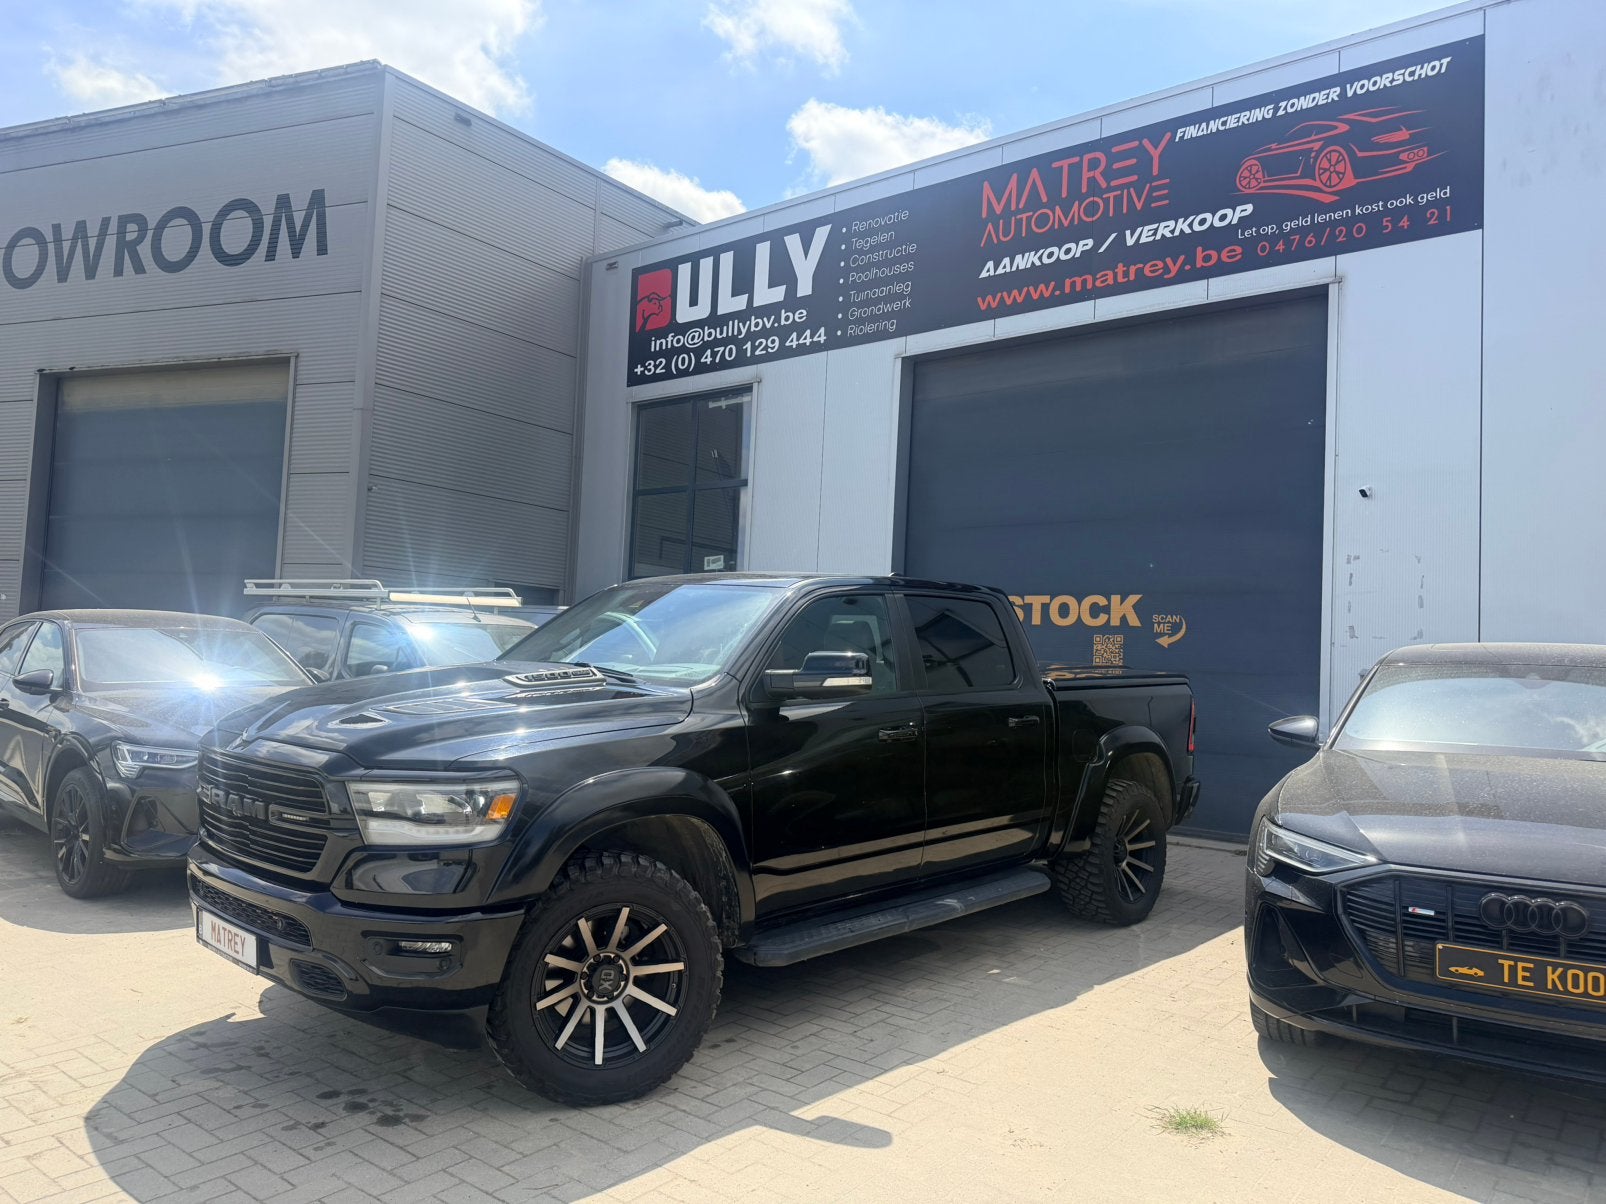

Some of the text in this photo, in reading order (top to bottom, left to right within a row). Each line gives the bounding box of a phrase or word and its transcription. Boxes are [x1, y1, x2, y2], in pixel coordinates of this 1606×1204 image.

[1175, 56, 1452, 142] FINANCIERING ZONDER VOORSCHOT
[981, 132, 1172, 219] MATREY
[851, 209, 909, 234] Renovatie
[980, 178, 1171, 248] AUTOMOTIVE
[1238, 185, 1450, 239] Let op, geld lenen kost ook geld
[851, 231, 895, 251] Tegelen
[978, 238, 1094, 279] AANKOOP
[1124, 203, 1254, 247] VERKOOP
[1257, 205, 1451, 257] 0476/20 54 21
[849, 261, 914, 285] Poolhouses
[850, 243, 917, 267] Constructie
[636, 224, 832, 333] BULLY
[850, 281, 912, 303] Tuinaanleg
[977, 245, 1243, 311] www.matrey.be
[848, 297, 912, 320] Grondwerk
[650, 308, 808, 352] info@bullybv.be
[847, 319, 897, 337] Riolering
[634, 327, 827, 375] +32 (0) 470 129 444
[1152, 614, 1181, 624] SCAN
[1153, 623, 1173, 634] ME
[212, 787, 266, 820] RAM
[211, 920, 246, 957] MATREY
[1498, 959, 1606, 997] TE KOO
